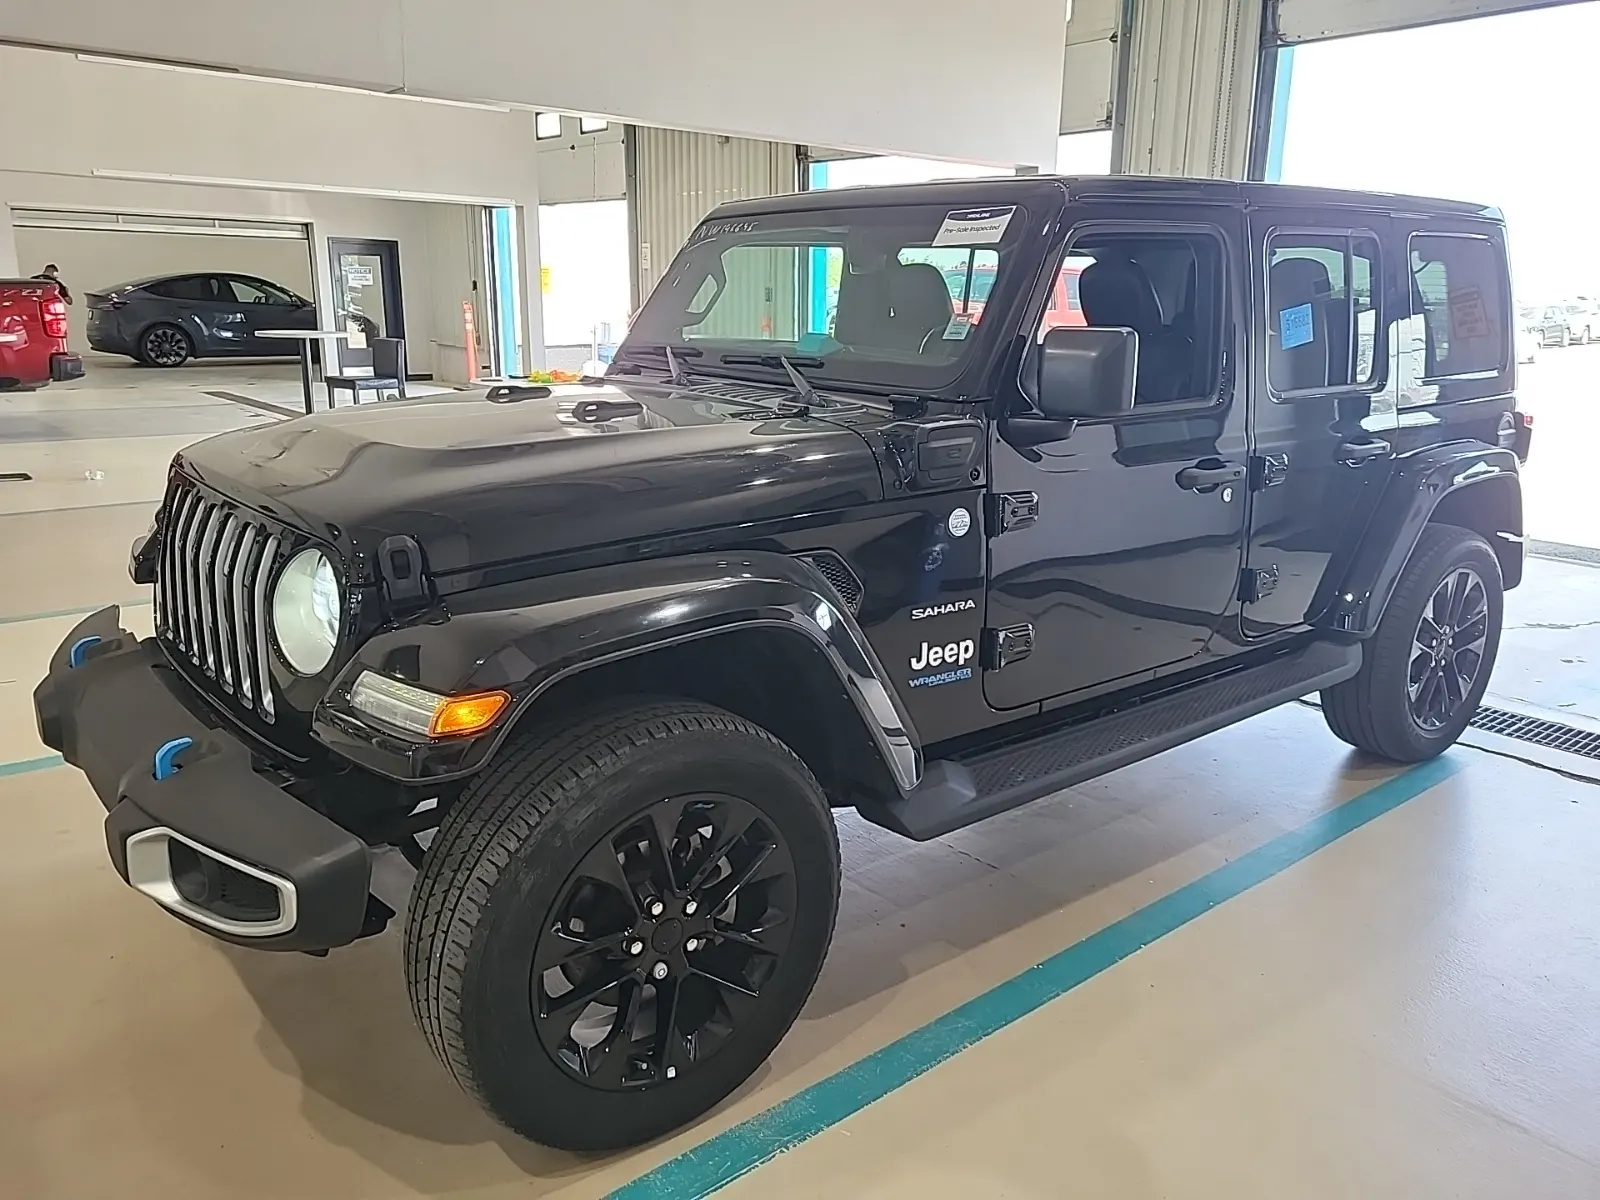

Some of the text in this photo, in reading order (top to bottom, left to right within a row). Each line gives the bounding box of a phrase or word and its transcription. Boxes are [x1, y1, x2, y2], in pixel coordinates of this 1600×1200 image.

[943, 223, 1001, 234] Pre-Sale Inspected
[911, 599, 976, 620] SAHARA
[910, 639, 974, 670] Jeep
[908, 667, 972, 688] WRANGLER
